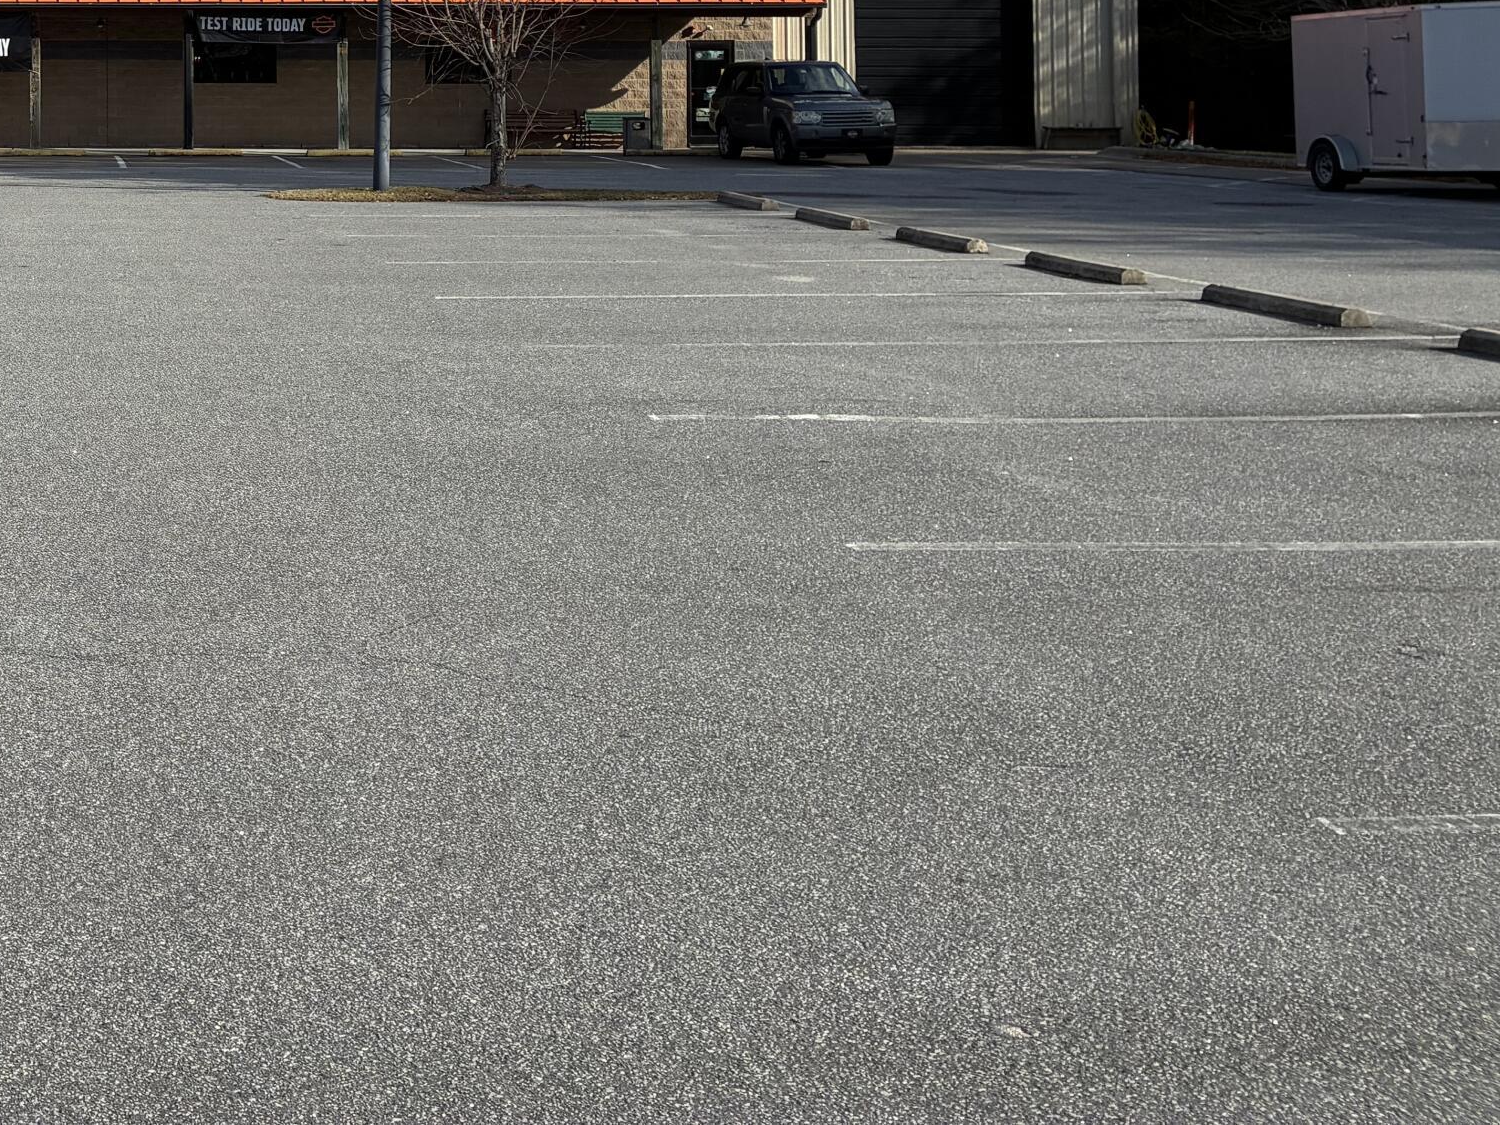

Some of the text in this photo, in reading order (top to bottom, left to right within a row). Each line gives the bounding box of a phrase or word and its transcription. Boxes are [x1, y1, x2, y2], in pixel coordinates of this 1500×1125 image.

[200, 16, 306, 32] TEST RIDE TODAY
